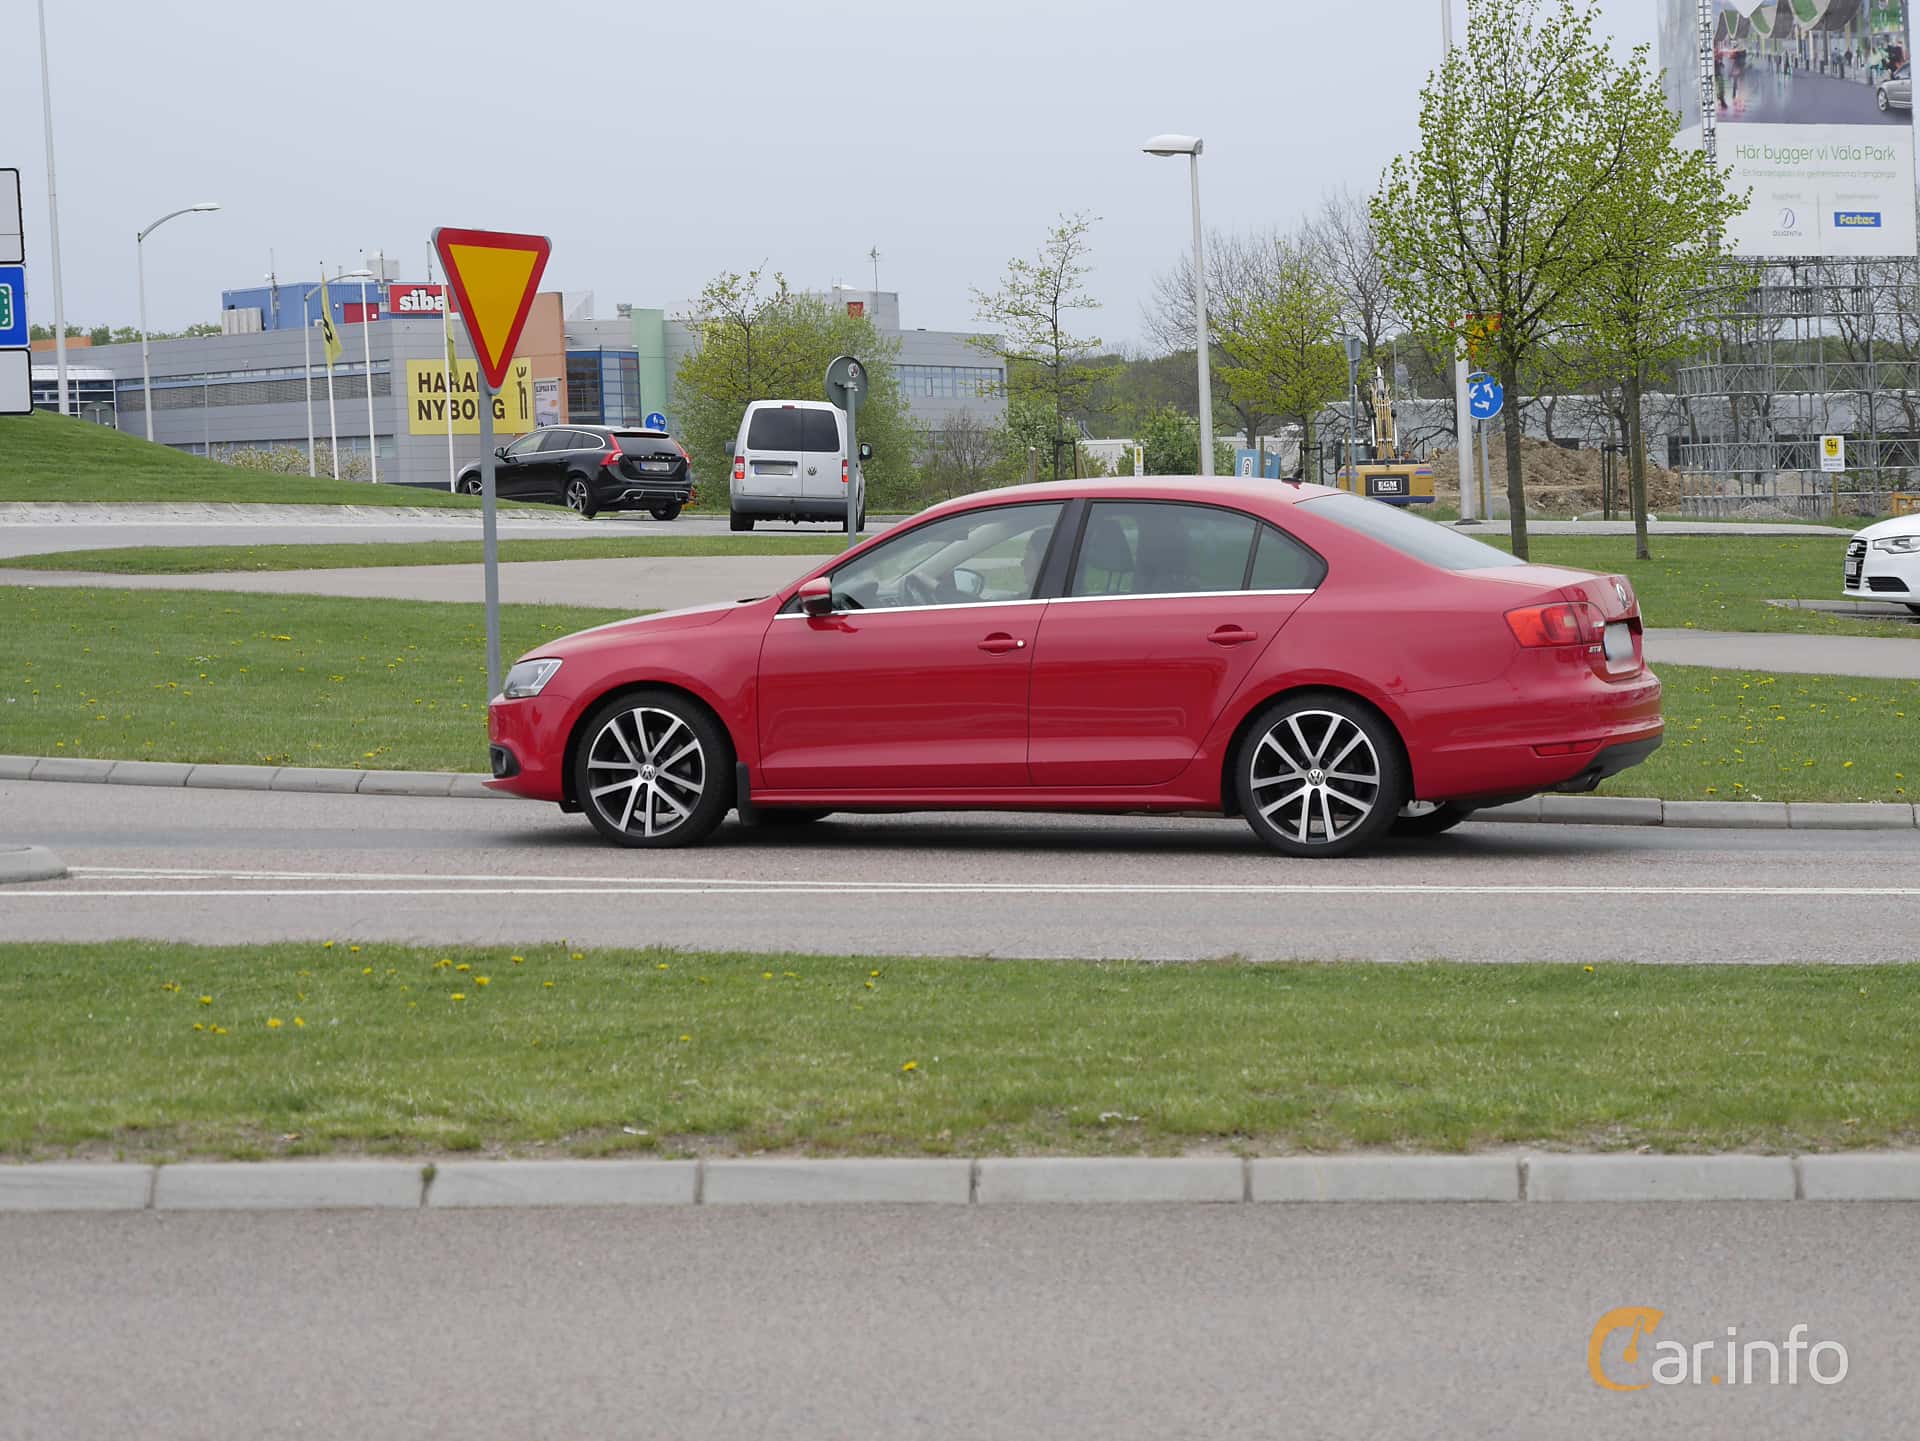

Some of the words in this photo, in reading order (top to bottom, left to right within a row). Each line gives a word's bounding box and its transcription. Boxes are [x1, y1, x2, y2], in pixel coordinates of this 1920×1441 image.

[1736, 144, 1760, 160] Här
[1764, 144, 1814, 165] bygger
[1818, 145, 1828, 160] vi
[1865, 145, 1896, 161] Park
[418, 372, 480, 393] HARA
[417, 398, 506, 421] NYBOG
